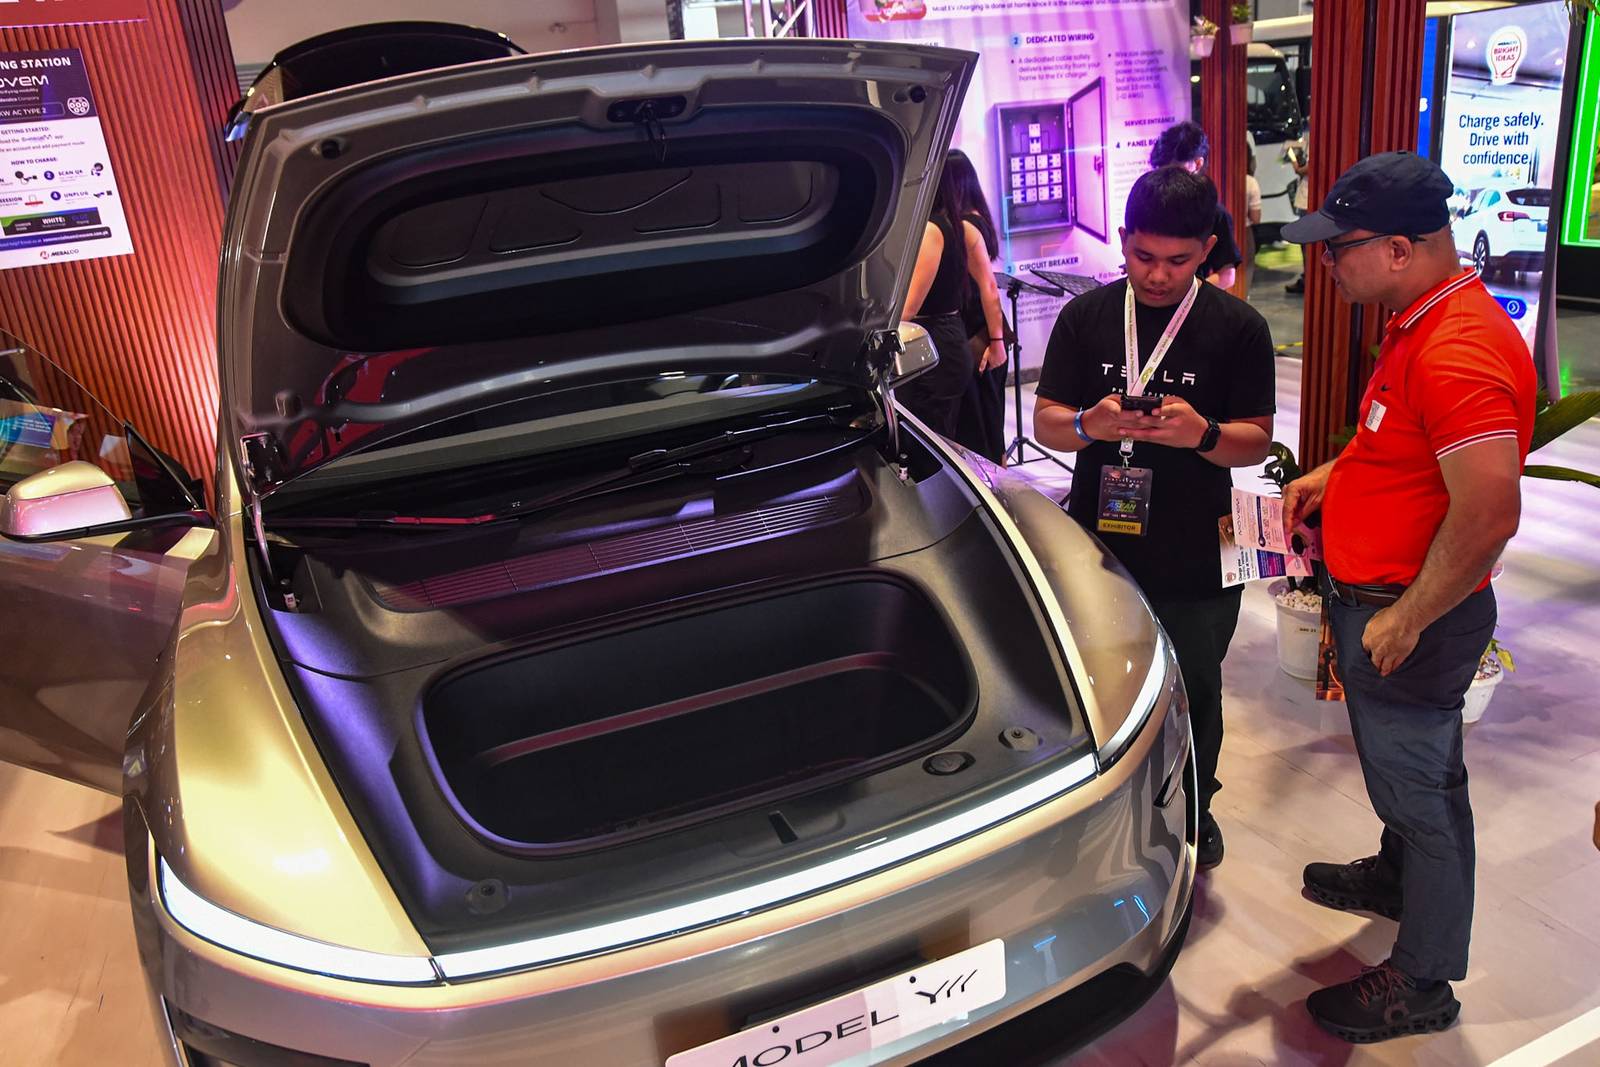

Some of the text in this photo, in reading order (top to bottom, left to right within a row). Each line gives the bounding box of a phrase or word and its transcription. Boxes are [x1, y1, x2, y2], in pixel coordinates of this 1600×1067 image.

[1026, 35, 1067, 44] DEDICATED
[1068, 33, 1095, 41] WIRING
[1493, 46, 1519, 55] BRIGHT
[20, 57, 72, 69] STATION
[1495, 54, 1515, 62] IDEAS
[1147, 117, 1176, 125] ENTRANCE
[1458, 111, 1544, 131] Charge safely.
[1127, 139, 1147, 147] PANEL
[1469, 130, 1529, 147] Drive with
[1463, 150, 1533, 166] confidence.
[1019, 261, 1047, 271] CIRCUIT
[1049, 256, 1079, 267] BREAKER
[1101, 363, 1196, 386] TELA
[1102, 523, 1137, 532] EXHIBITOR
